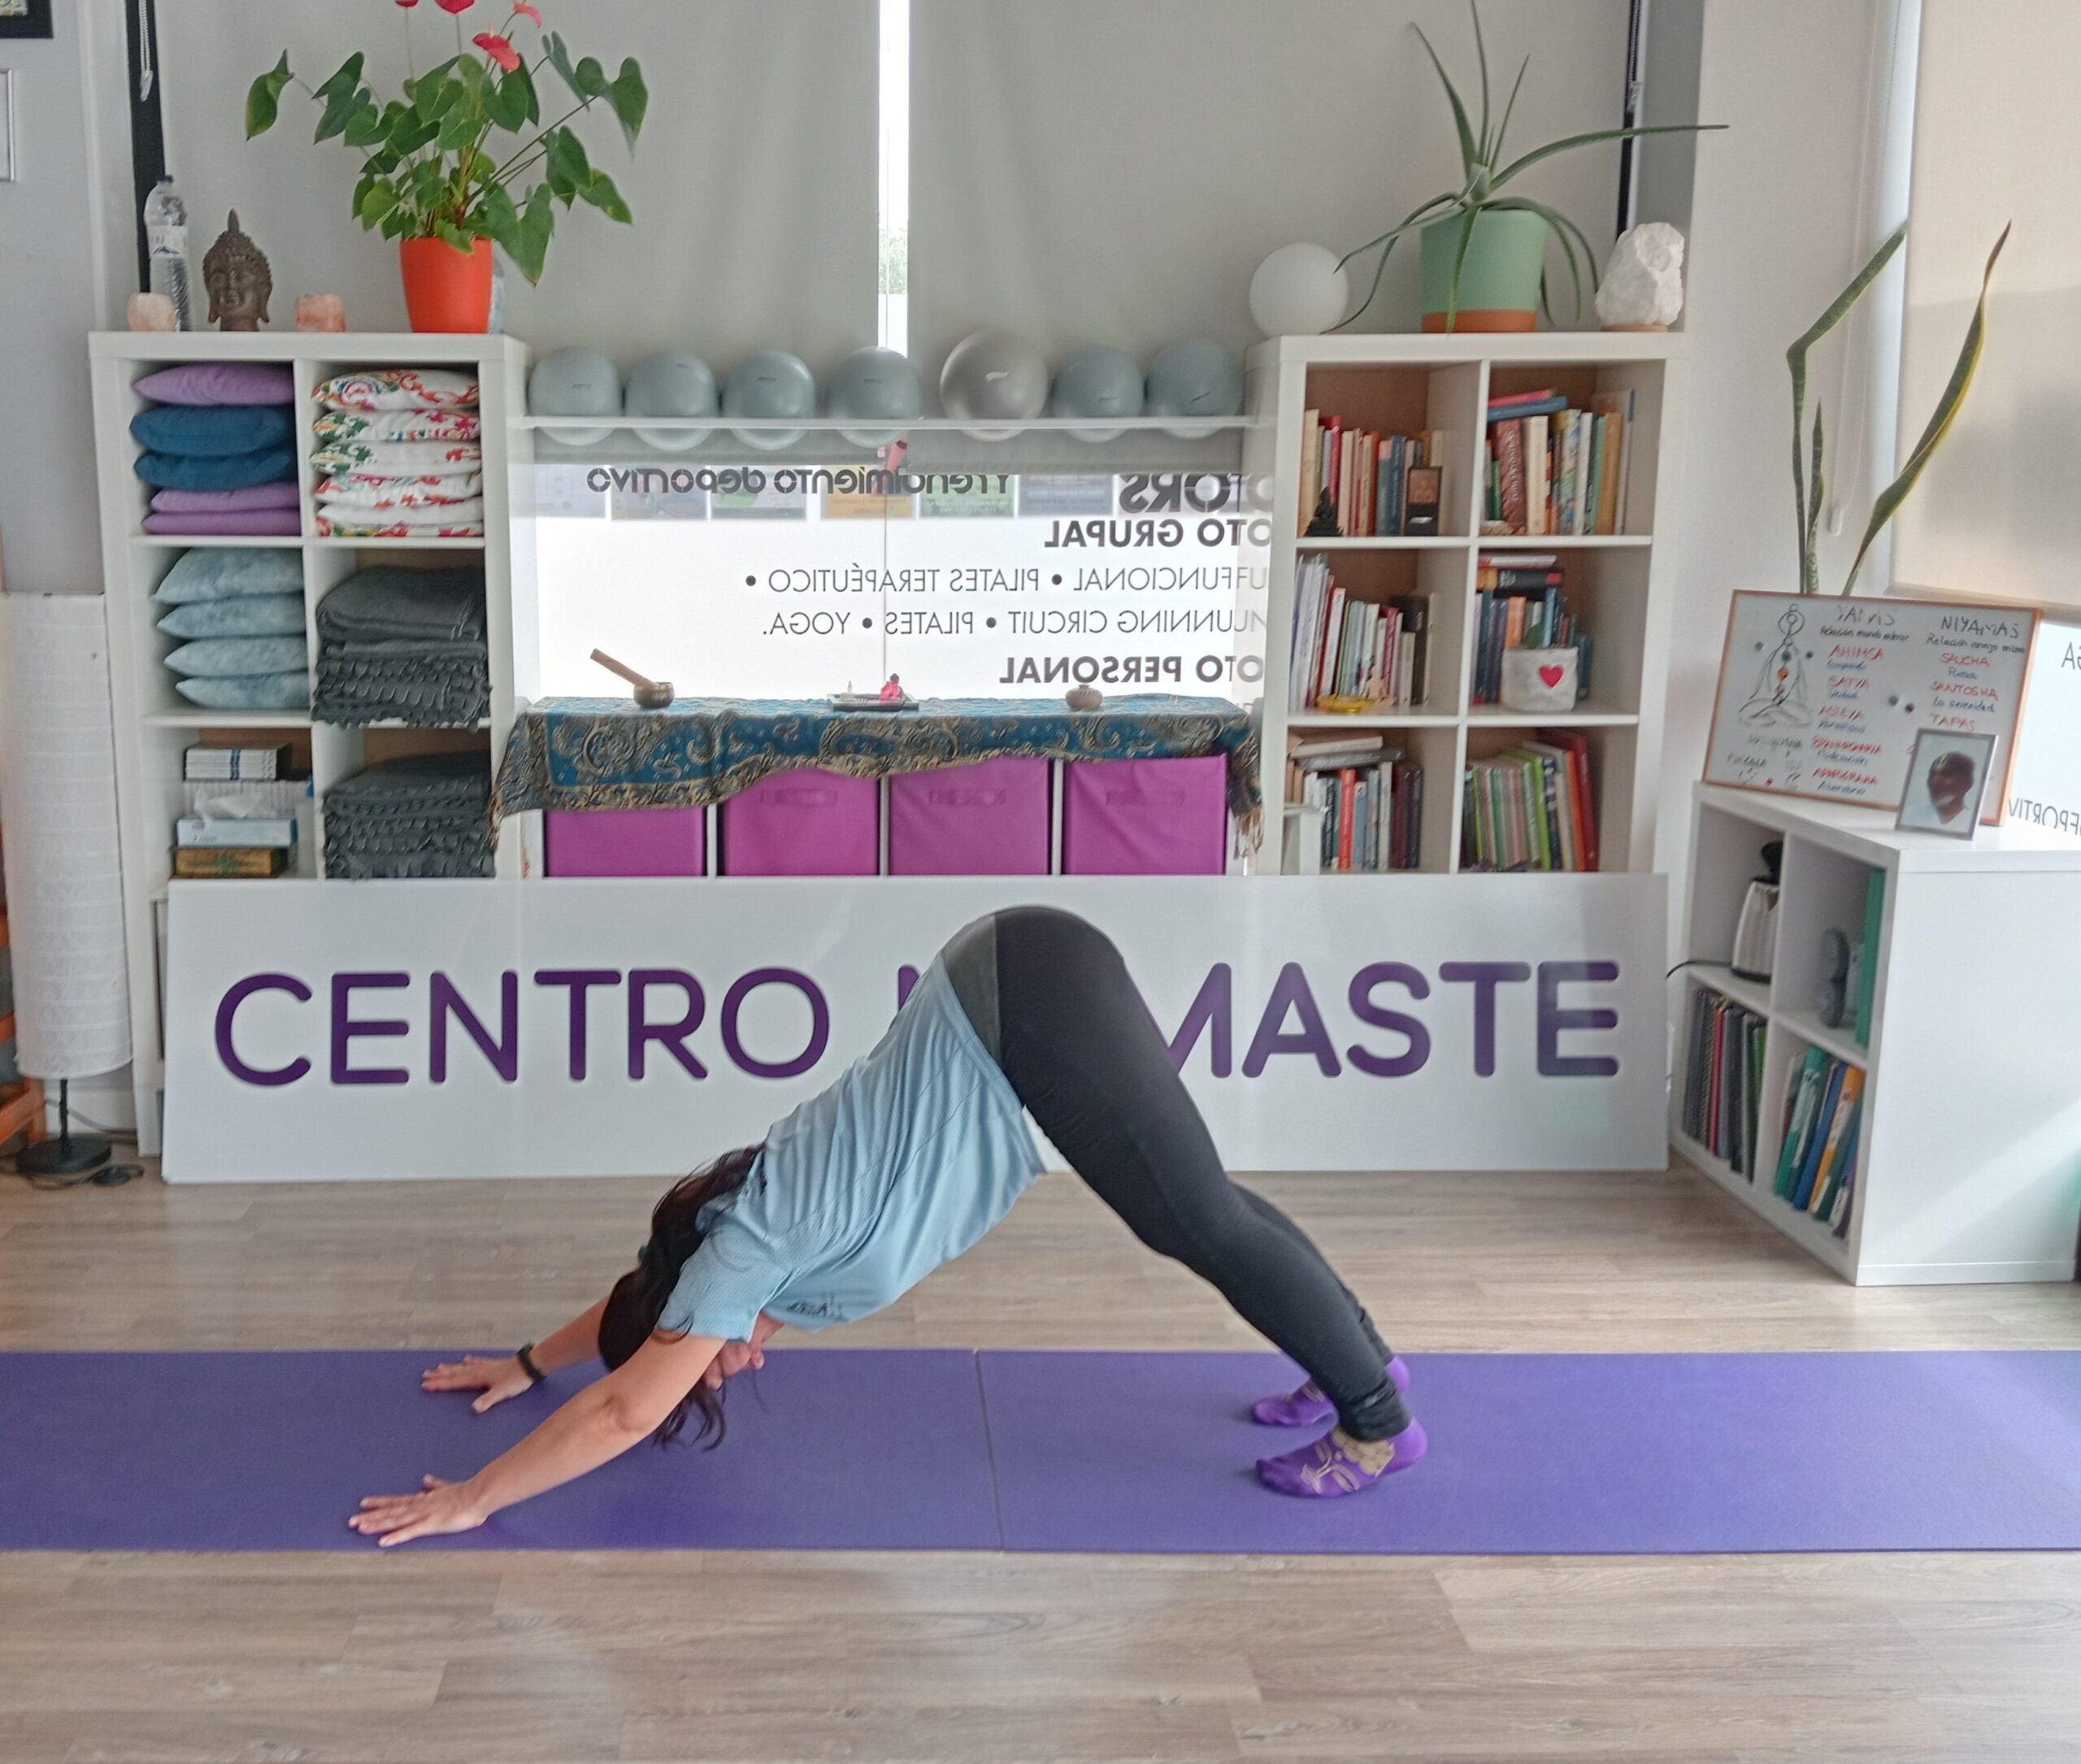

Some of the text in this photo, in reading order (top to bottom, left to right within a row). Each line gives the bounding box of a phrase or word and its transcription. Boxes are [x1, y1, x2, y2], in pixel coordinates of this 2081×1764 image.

[1940, 615, 2020, 639] NIYAMAS
[1930, 713, 1976, 732] TAPAS
[215, 967, 830, 1086] CENTRO
